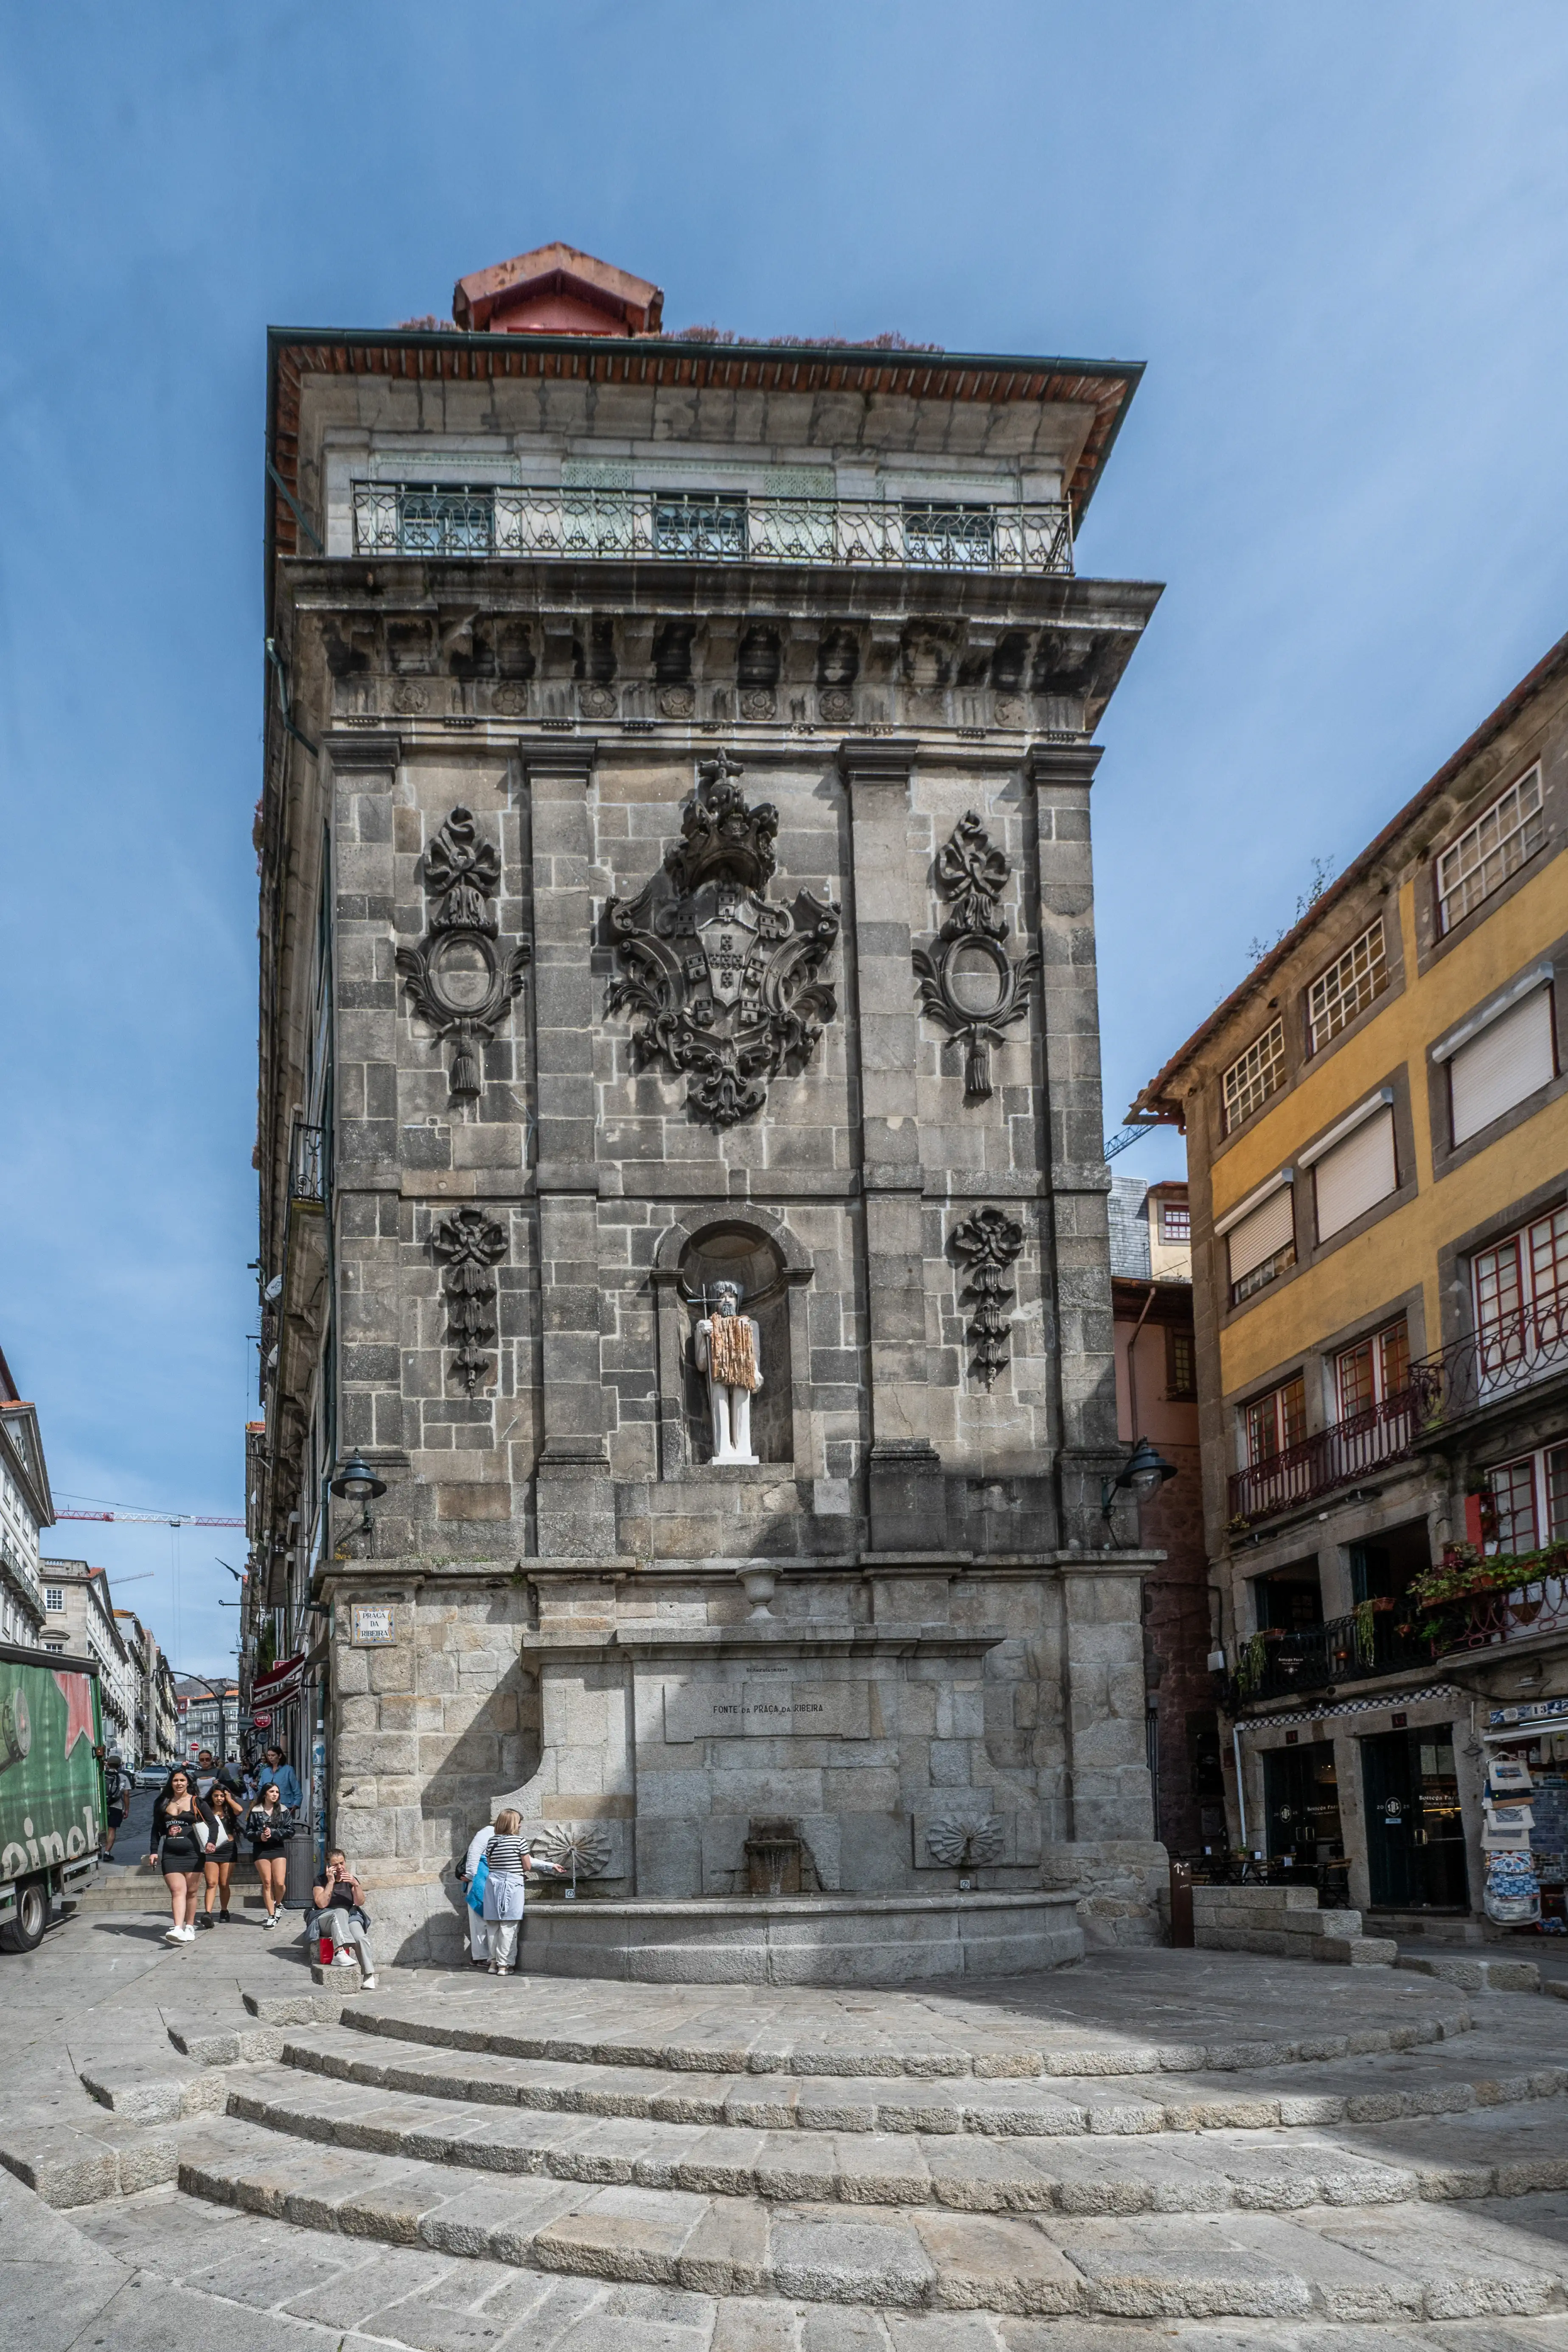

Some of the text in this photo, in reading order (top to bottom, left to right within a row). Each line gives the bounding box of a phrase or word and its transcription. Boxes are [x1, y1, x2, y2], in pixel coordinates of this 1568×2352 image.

[754, 1705, 778, 1715] PRAÇA
[794, 1704, 823, 1712] RIBEIRA
[1533, 1705, 1547, 1714] 13
